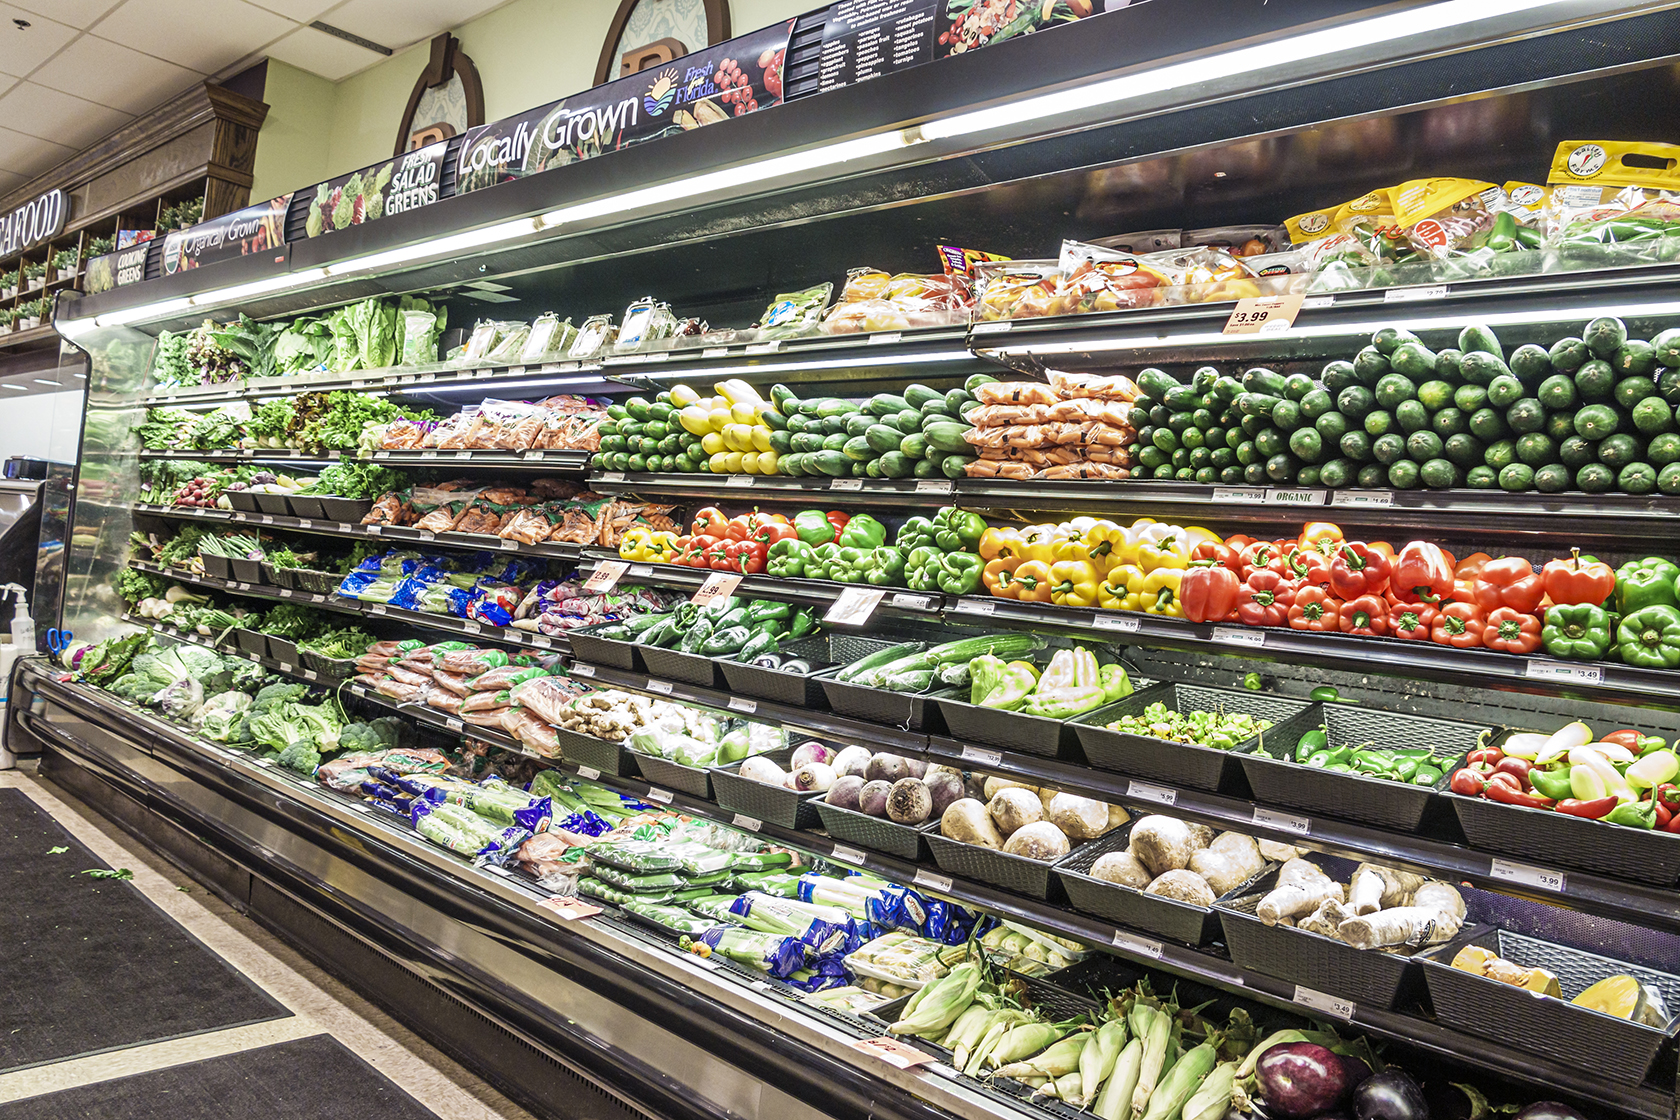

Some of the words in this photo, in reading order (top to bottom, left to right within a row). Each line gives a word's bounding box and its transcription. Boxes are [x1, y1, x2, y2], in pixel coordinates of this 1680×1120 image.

[912, 16, 934, 27] potatoes
[879, 35, 890, 43] fruit
[684, 60, 714, 83] Fresh
[675, 79, 714, 105] Florida
[459, 121, 538, 175] Locally
[543, 96, 639, 151] Grown
[400, 150, 433, 173] FRESH
[1570, 163, 1599, 174] Farms
[390, 161, 436, 194] SALAD
[384, 182, 440, 216] GREENS
[185, 224, 228, 257] Organically
[228, 217, 260, 241] Grown
[117, 248, 147, 270] COOKING
[117, 268, 142, 287] GREENS
[1235, 311, 1268, 323] $3.99
[1276, 492, 1312, 503] ORGANIC
[1540, 875, 1559, 886] $3.99
